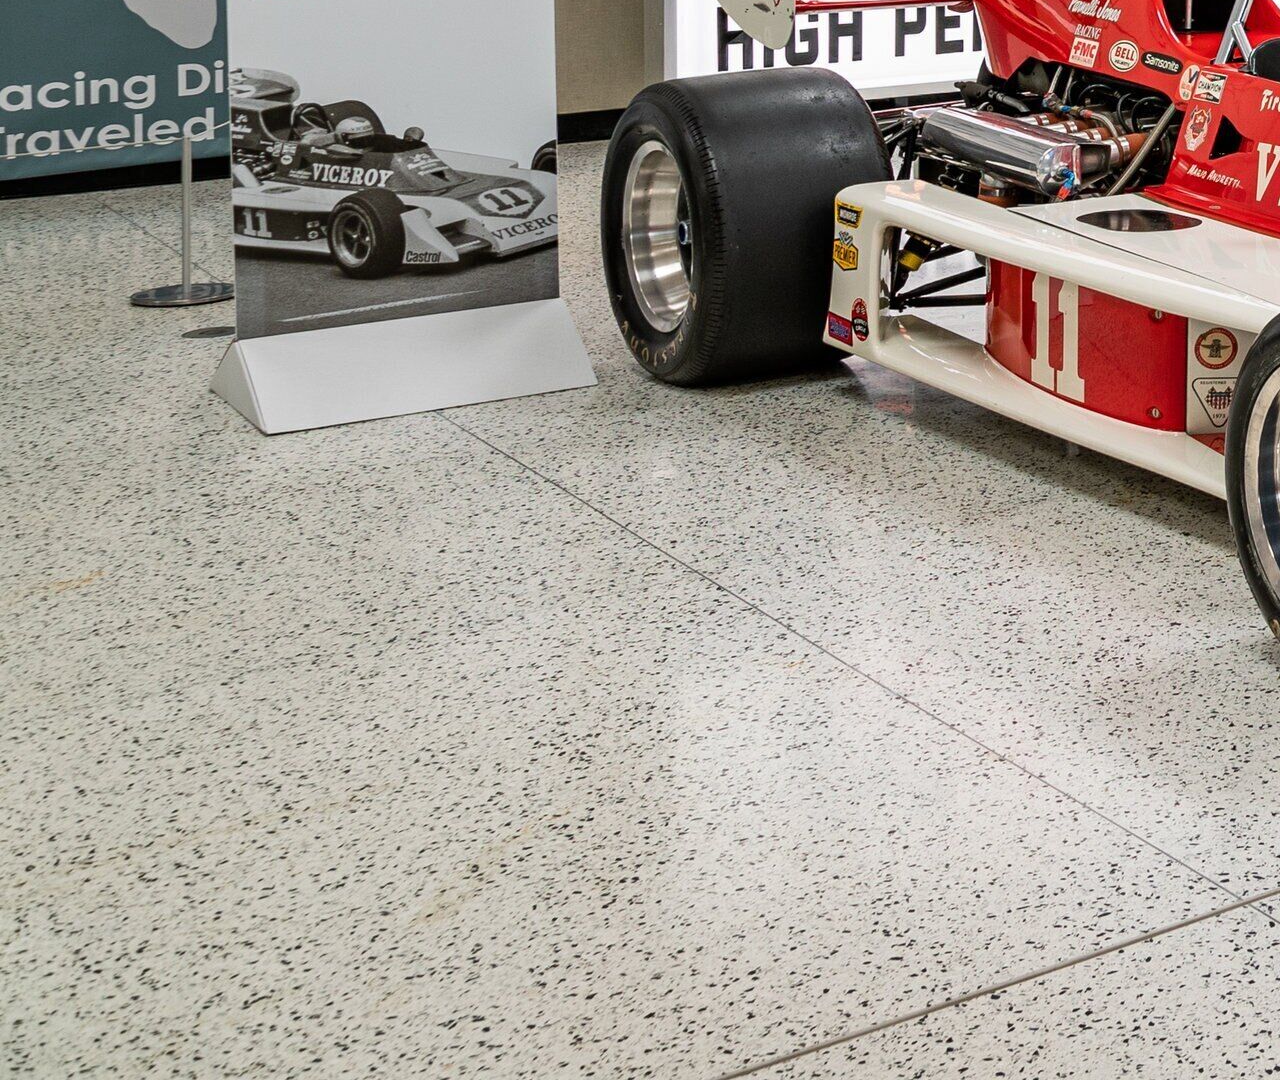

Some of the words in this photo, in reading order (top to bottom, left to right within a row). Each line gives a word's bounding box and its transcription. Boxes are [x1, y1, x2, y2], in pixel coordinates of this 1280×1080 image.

[1074, 23, 1100, 39] RACING
[1072, 43, 1097, 57] FMC
[1114, 45, 1135, 61] BELL
[1144, 55, 1180, 71] Samsonite
[0, 70, 156, 112] acing
[1199, 80, 1223, 92] CHAMPION
[311, 163, 394, 188] VICEROY
[1187, 163, 1208, 182] MARIO
[1208, 169, 1242, 189] ANDRETTI
[484, 189, 534, 212] 11
[242, 209, 272, 238] 11
[405, 250, 441, 263] Castrol
[833, 243, 859, 263] PREMIER
[1031, 271, 1086, 403] 11
